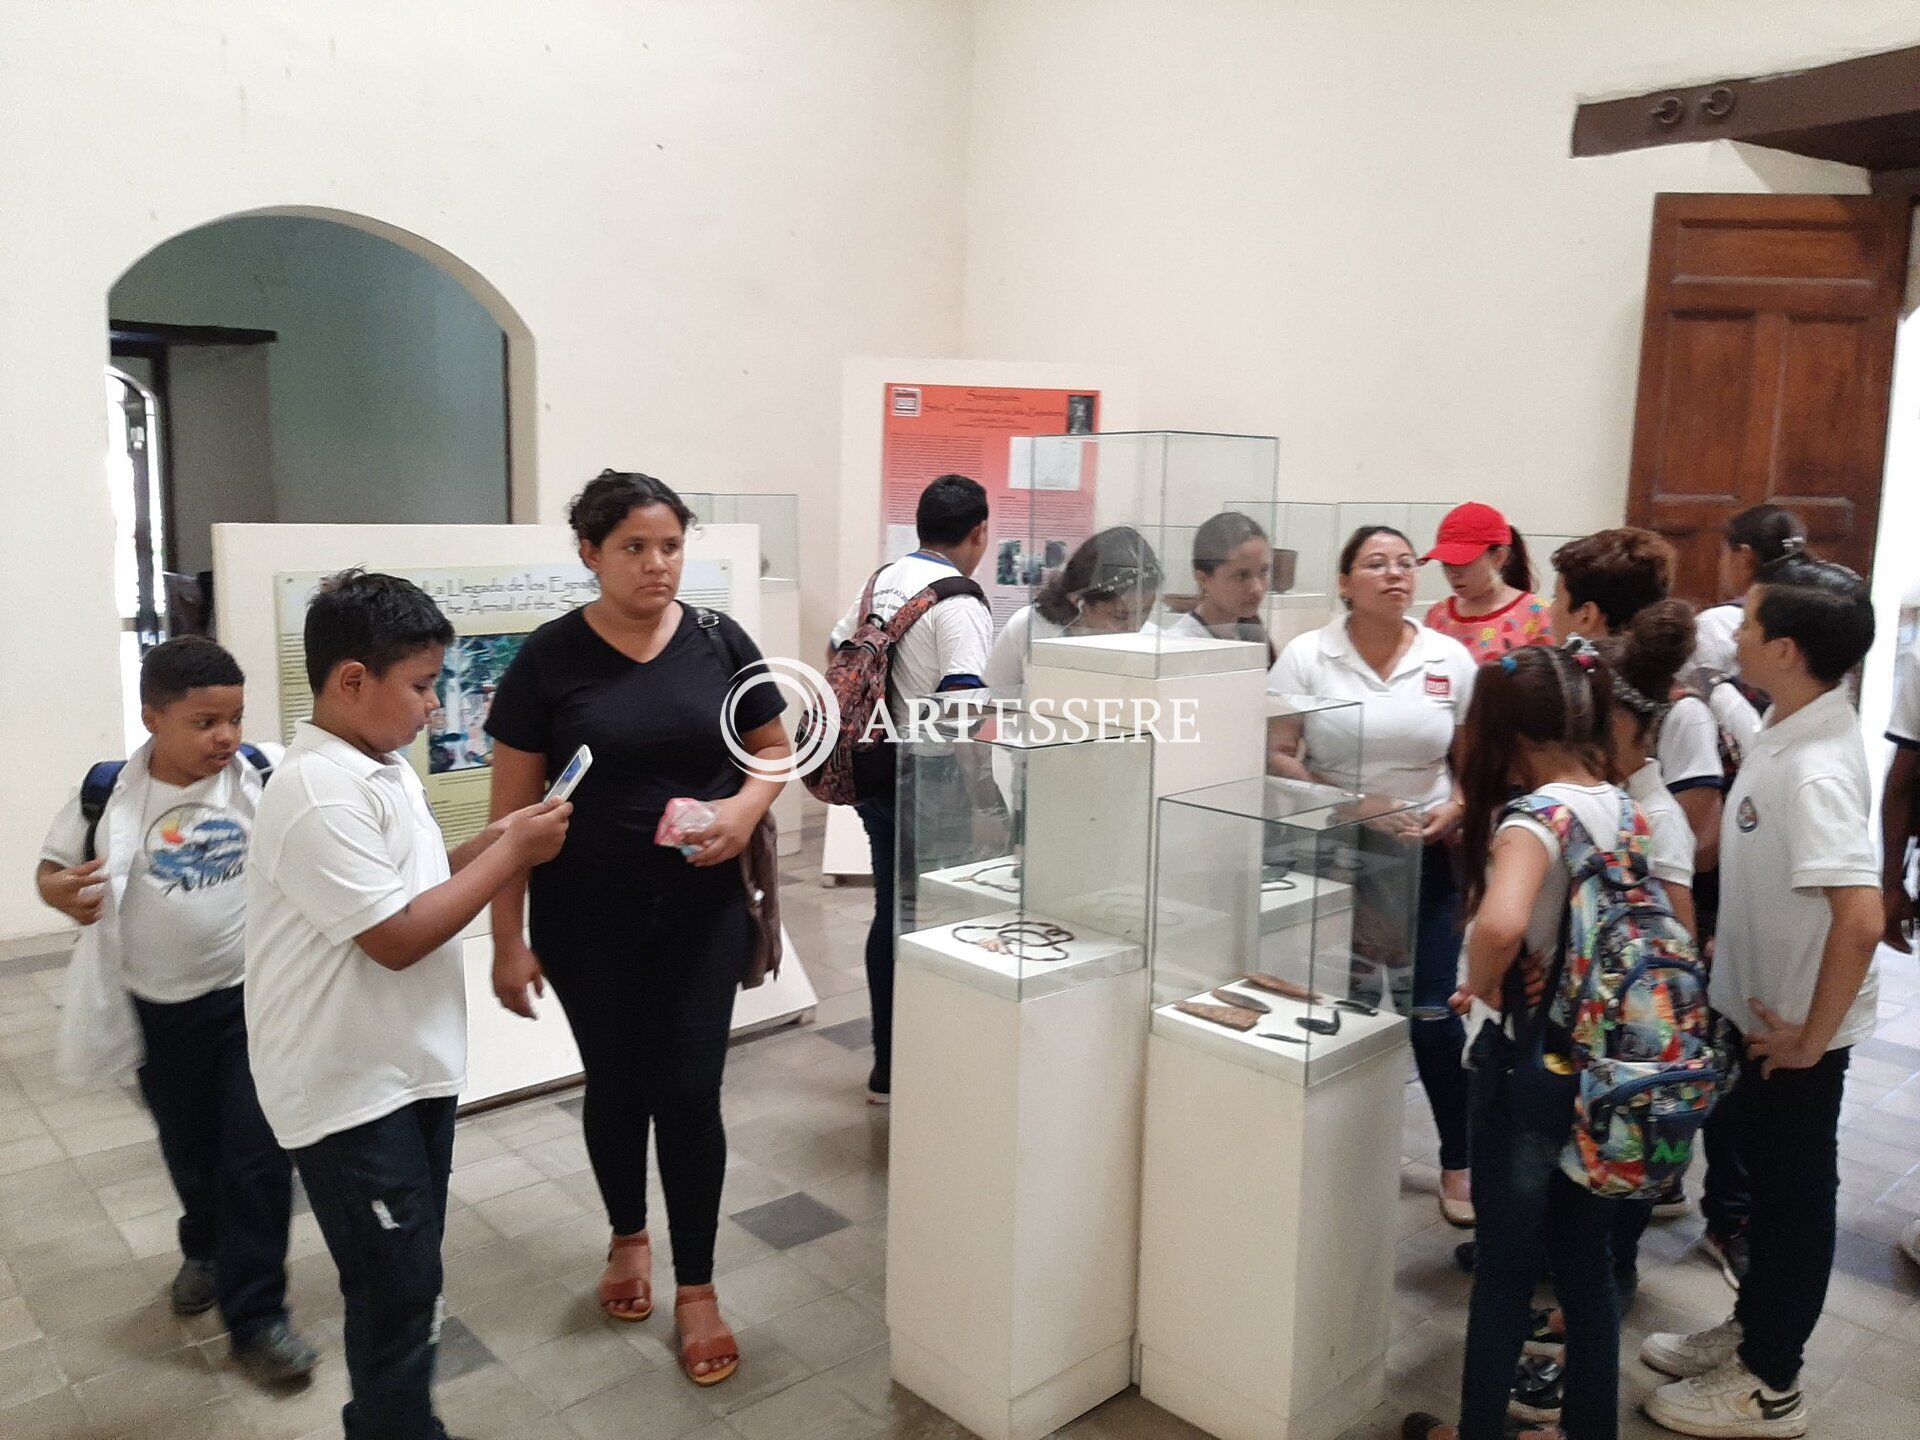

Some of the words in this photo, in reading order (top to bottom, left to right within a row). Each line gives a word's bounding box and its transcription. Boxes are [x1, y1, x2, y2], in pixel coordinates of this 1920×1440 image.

[447, 577, 505, 598] Llegada
[507, 576, 524, 591] de
[525, 573, 547, 591] los
[467, 596, 515, 615] Arrival
[517, 594, 533, 611] of
[534, 594, 556, 610] the
